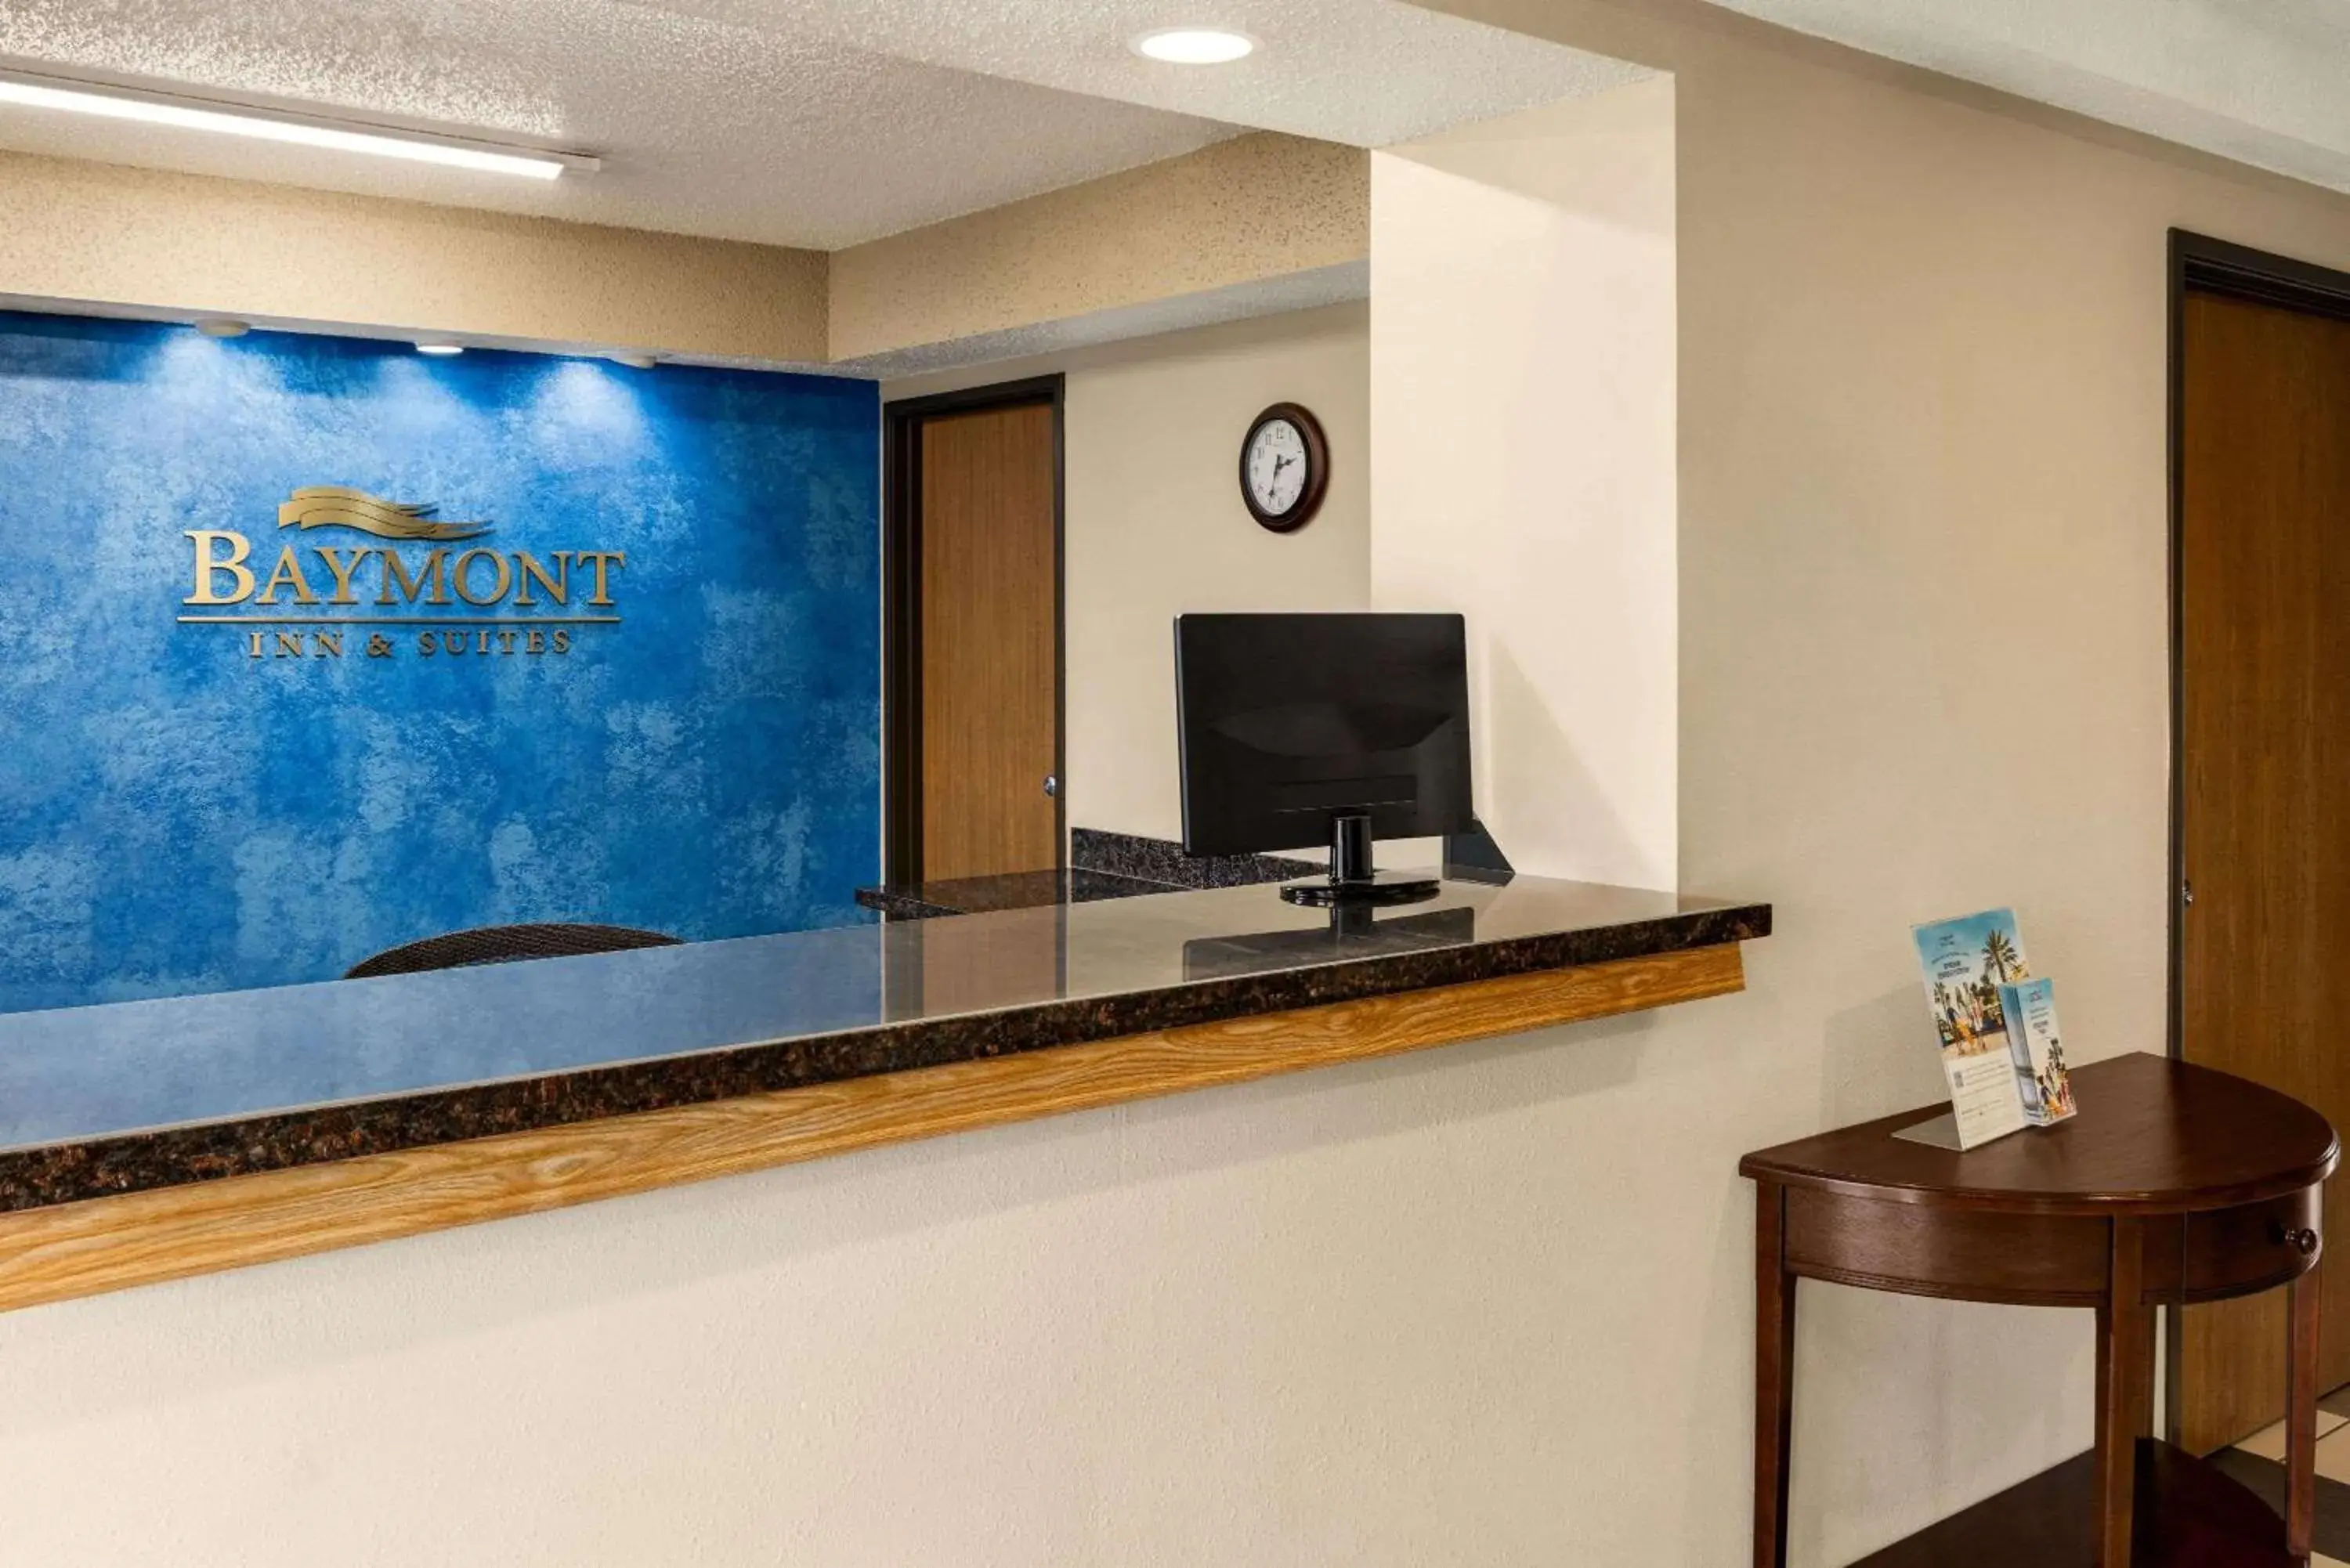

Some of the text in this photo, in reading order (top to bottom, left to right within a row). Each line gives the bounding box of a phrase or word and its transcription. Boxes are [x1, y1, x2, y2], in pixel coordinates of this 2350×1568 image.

[182, 529, 626, 606] BAYMONT
[249, 628, 571, 659] INN & SUITES
